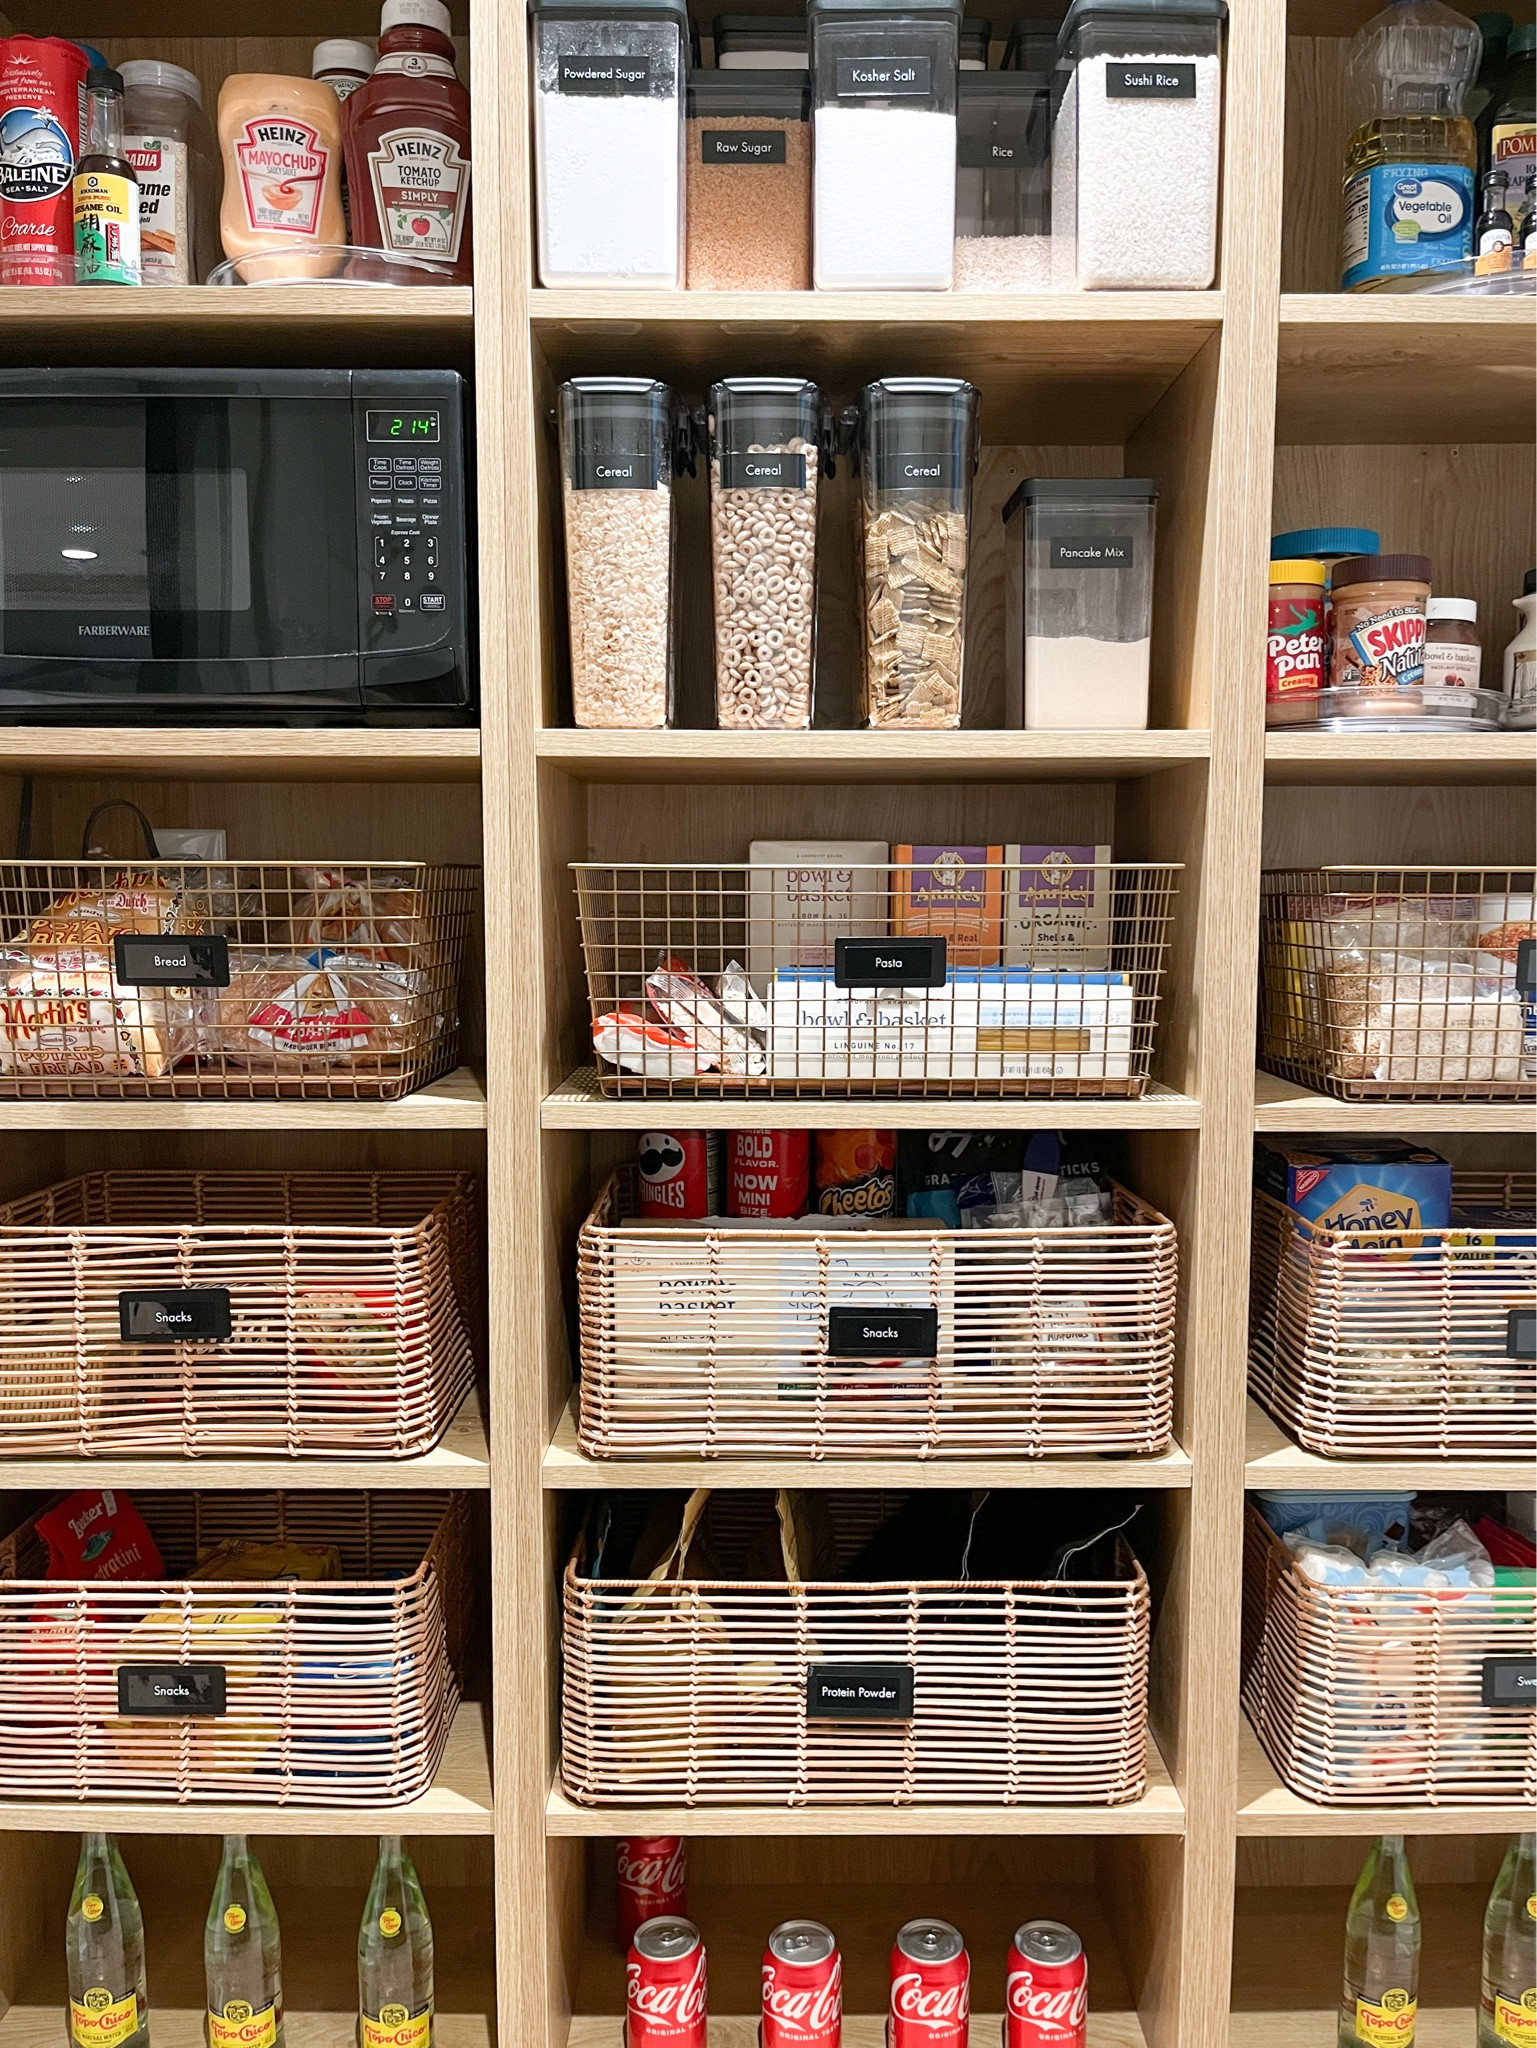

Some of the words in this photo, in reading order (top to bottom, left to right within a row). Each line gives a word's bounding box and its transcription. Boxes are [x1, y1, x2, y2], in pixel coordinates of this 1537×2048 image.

[411, 58, 418, 66] 3
[564, 68, 613, 80] Powdered
[616, 69, 646, 82] Sugar
[852, 69, 890, 82] Kosher
[893, 68, 916, 81] Salt
[1124, 74, 1152, 87] Sushi
[1156, 74, 1179, 87] Rice
[337, 82, 355, 90] HEINZ
[257, 127, 307, 146] HEINZ
[396, 142, 442, 160] HEINZ
[716, 142, 739, 153] Raw
[742, 141, 772, 155] Sugar
[992, 146, 1013, 158] Rice
[126, 153, 158, 167] ADIA
[248, 151, 317, 171] MAYOCHUP
[266, 166, 282, 175] SAUCY
[282, 168, 297, 176] SAUCE
[398, 165, 442, 179] TOMATO
[1382, 168, 1428, 178] FRYING
[400, 176, 440, 187] KETCHUP
[401, 190, 439, 203] SIMPLY
[75, 203, 104, 214] SESAME
[106, 205, 122, 214] OIL
[1399, 201, 1452, 213] Vegetable
[1437, 214, 1452, 224] Oil
[0, 216, 57, 240] Coarse
[595, 464, 633, 478] Cereal
[745, 463, 782, 476] Cereal
[904, 463, 941, 477] Cereal
[395, 516, 416, 524] Beverage
[379, 539, 385, 547] 1
[403, 539, 410, 547] 2
[427, 539, 434, 547] 3
[1060, 546, 1102, 559] Pancake
[1104, 547, 1125, 557] Mix
[379, 556, 386, 564] 4
[403, 556, 410, 564] 5
[427, 556, 434, 564] 6
[379, 572, 386, 580] 7
[404, 572, 411, 580] 8
[428, 572, 435, 580] 9
[404, 598, 411, 606] 0
[1356, 620, 1369, 631] No
[1370, 611, 1393, 624] Need
[78, 625, 150, 636] FARBERWARE
[1268, 634, 1323, 657] Peter
[1424, 651, 1445, 661] bowl
[1446, 653, 1454, 661] &
[1274, 653, 1321, 679] Pan
[1281, 676, 1315, 689] Creamy
[786, 868, 833, 883] bowl
[915, 886, 981, 902] Annie's
[1024, 886, 1087, 902] Annie's
[957, 933, 978, 942] Real
[1067, 933, 1075, 942] &
[154, 955, 187, 967] Bread
[874, 957, 903, 969] Pasta
[1, 1000, 89, 1041] Martin's
[801, 1011, 849, 1026] bowl
[878, 1011, 947, 1026] basket
[834, 1042, 880, 1050] LINGUINE
[30, 1062, 105, 1076] BREAD
[736, 1136, 773, 1159] BOLD
[734, 1158, 779, 1168] FLAVOR.
[734, 1173, 778, 1191] NOW
[738, 1190, 771, 1206] MINI
[821, 1181, 894, 1216] Cheetos
[739, 1206, 771, 1217] SIZE.
[1324, 1207, 1414, 1231] Honey
[1465, 1234, 1482, 1246] 16
[1454, 1252, 1492, 1261] VALUE
[155, 1310, 193, 1323] Snacks
[862, 1326, 899, 1338] Snacks
[154, 1684, 190, 1696] Snacks
[821, 1686, 856, 1698] Protein
[858, 1686, 897, 1699] Powder
[73, 2008, 101, 2028] Topo
[100, 2008, 133, 2030] Chico
[1361, 2008, 1395, 2029] Topo
[211, 2019, 240, 2040] Topo
[240, 2019, 273, 2042] Chico
[365, 2025, 395, 2044] Topo
[394, 2025, 427, 2046] Chico
[645, 2026, 687, 2036] ORIGINAL
[778, 2030, 820, 2041] ORIGINAL
[1038, 2030, 1078, 2041] ORIGINAL
